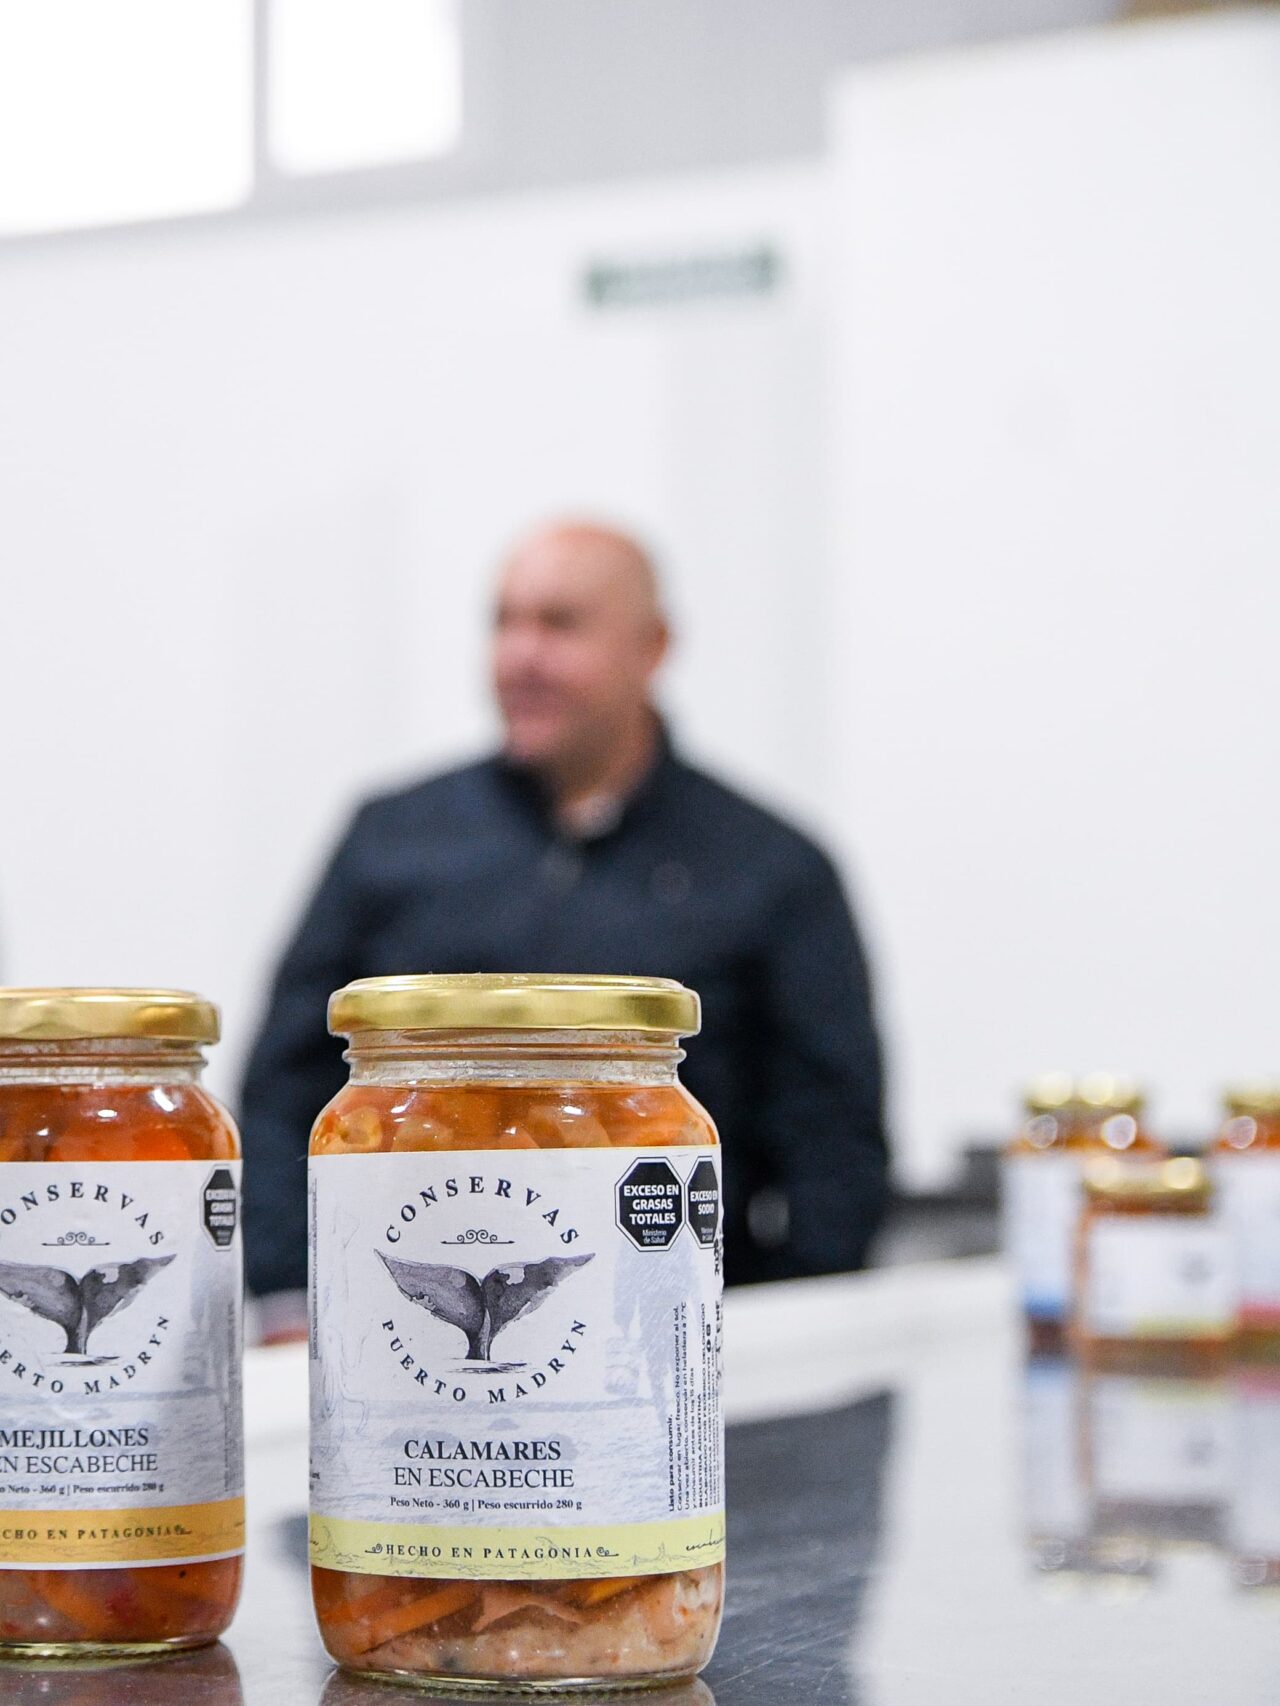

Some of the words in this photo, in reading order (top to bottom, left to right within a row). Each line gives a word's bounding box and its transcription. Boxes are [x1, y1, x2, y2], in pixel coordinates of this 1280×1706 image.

[623, 1185, 665, 1196] EXCESO
[666, 1184, 679, 1195] EN
[690, 1191, 712, 1202] EXCESO
[386, 1176, 578, 1244] CONSERVAS
[632, 1199, 673, 1211] GRASAS
[629, 1213, 676, 1225] TOTALES
[85, 1316, 169, 1395] MADRYN
[382, 1319, 466, 1402] PUERTO
[488, 1320, 586, 1404] MADRYN
[675, 1375, 680, 1388] No
[0, 1428, 149, 1449] MEJILLONES
[404, 1440, 561, 1460] CALAMARES
[677, 1450, 681, 1461] en
[26, 1453, 158, 1474] ESCABECHE
[393, 1467, 422, 1486] EN
[429, 1468, 574, 1488] ESCABECHE
[8, 1485, 30, 1494] Neto
[39, 1485, 56, 1494] 360
[59, 1486, 65, 1495] g
[73, 1485, 94, 1494] Peso
[97, 1483, 140, 1493] escurrido
[390, 1497, 410, 1507] Peso
[412, 1498, 434, 1508] Neto
[443, 1499, 460, 1509] 360
[463, 1501, 469, 1511] g
[478, 1500, 501, 1510] Peso
[504, 1499, 553, 1510] escurrido
[556, 1499, 573, 1509] 280
[576, 1501, 582, 1511] g
[47, 1529, 68, 1539] EN
[78, 1526, 170, 1540] PATAGONIA
[386, 1544, 441, 1557] HECHO
[452, 1547, 472, 1558] EN
[484, 1548, 592, 1559] PATAGONIA
